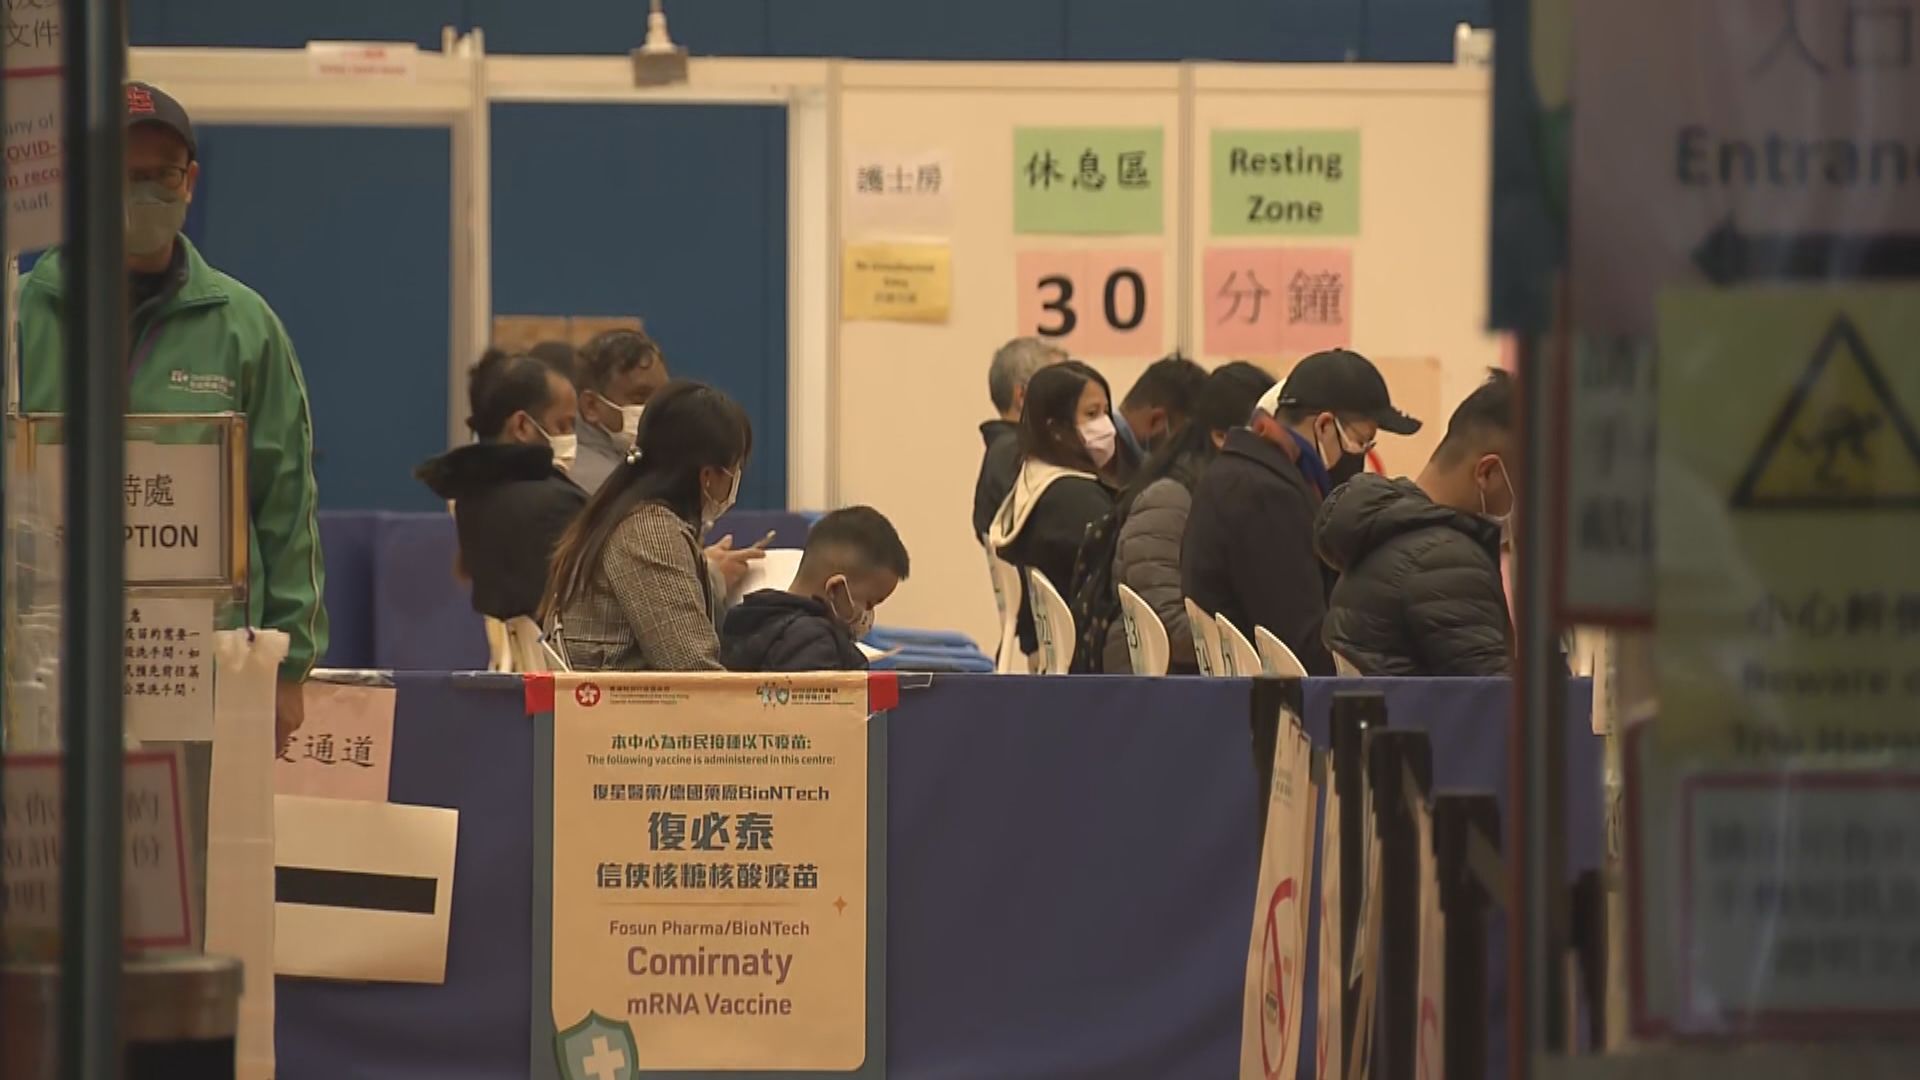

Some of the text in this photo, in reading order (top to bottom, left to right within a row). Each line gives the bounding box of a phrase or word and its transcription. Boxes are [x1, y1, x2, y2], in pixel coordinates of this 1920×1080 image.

[1024, 148, 1151, 191] 休息區
[1229, 146, 1343, 181] Resting
[1677, 124, 1920, 188] Entran
[1247, 195, 1323, 222] Zone
[1216, 267, 1344, 326] 分鐘
[586, 753, 835, 767] The following vaccine is administered in this centre:
[648, 812, 773, 851] 復必泰
[596, 862, 818, 889] 信使核糖核酸疫苗
[610, 920, 809, 935] Fosun Pharma/BioNTech
[627, 946, 793, 985] Comirnaty
[627, 993, 792, 1015] mRNA Vaccine
